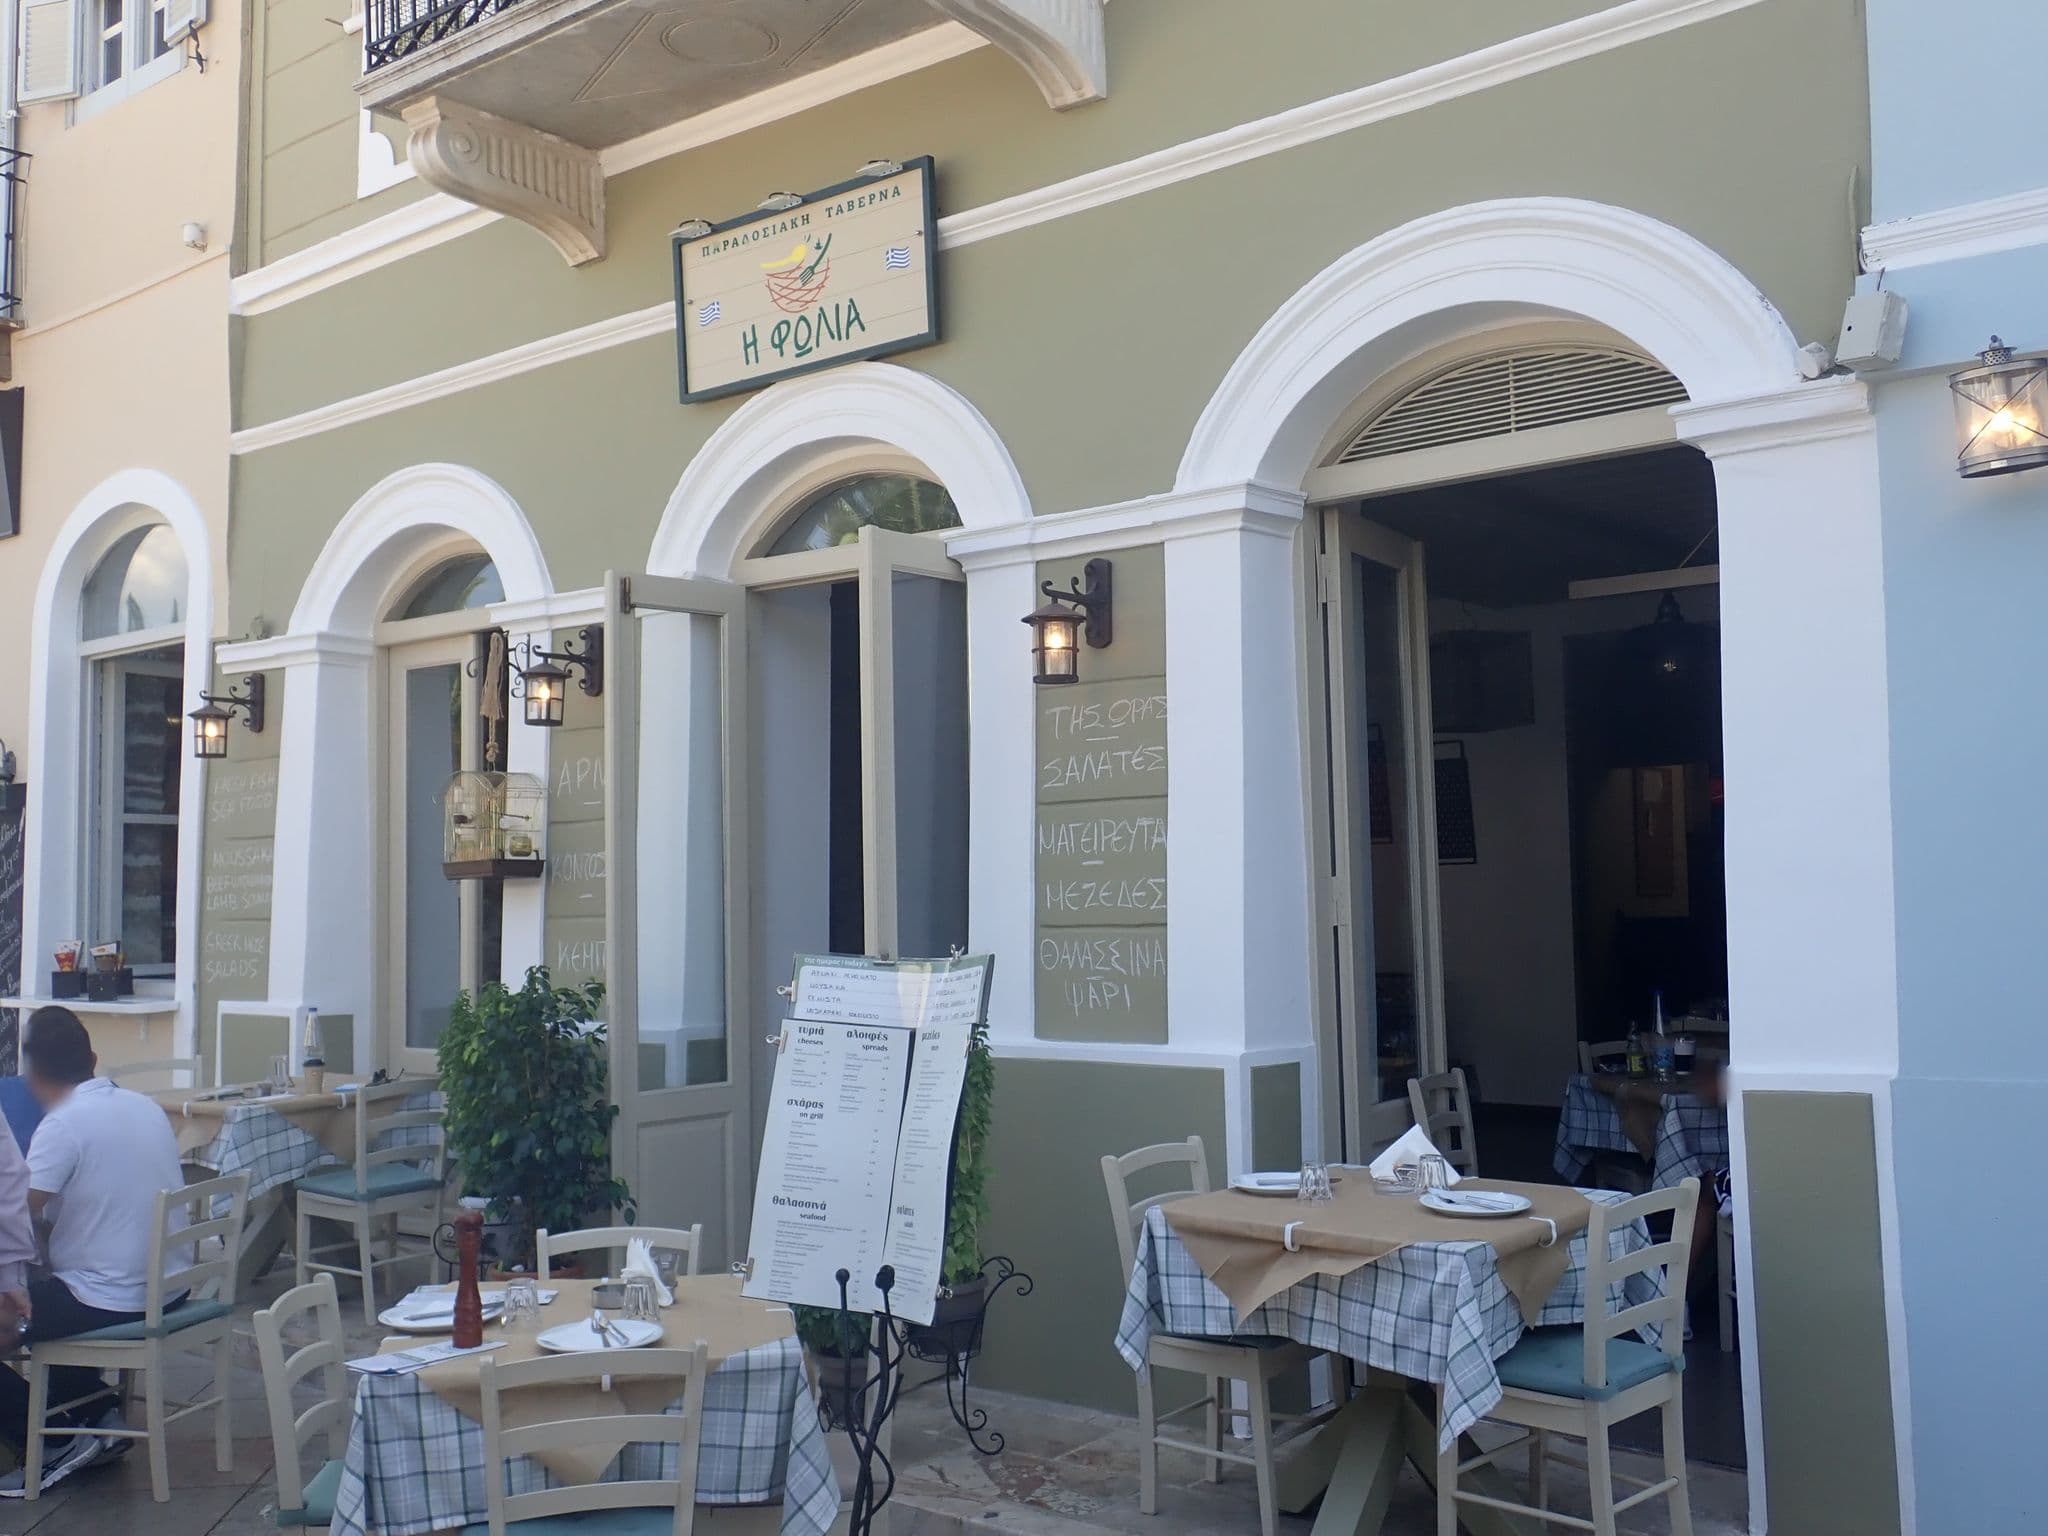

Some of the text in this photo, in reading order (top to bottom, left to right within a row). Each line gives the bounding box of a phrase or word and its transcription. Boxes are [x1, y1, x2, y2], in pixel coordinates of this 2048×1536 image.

[825, 185, 902, 219] ΤΑΒΕΡΝΑ
[742, 297, 866, 366] Η ΦΩΛΙΑ
[1046, 877, 1167, 912] ΜΕΖΕΔΕΣ
[798, 1026, 825, 1037] τυριά
[797, 1038, 824, 1046] cheeses
[862, 1044, 889, 1052] spreads
[809, 1111, 824, 1120] grill
[772, 1195, 827, 1211] θαλασσινά
[799, 1213, 827, 1222] seafood
